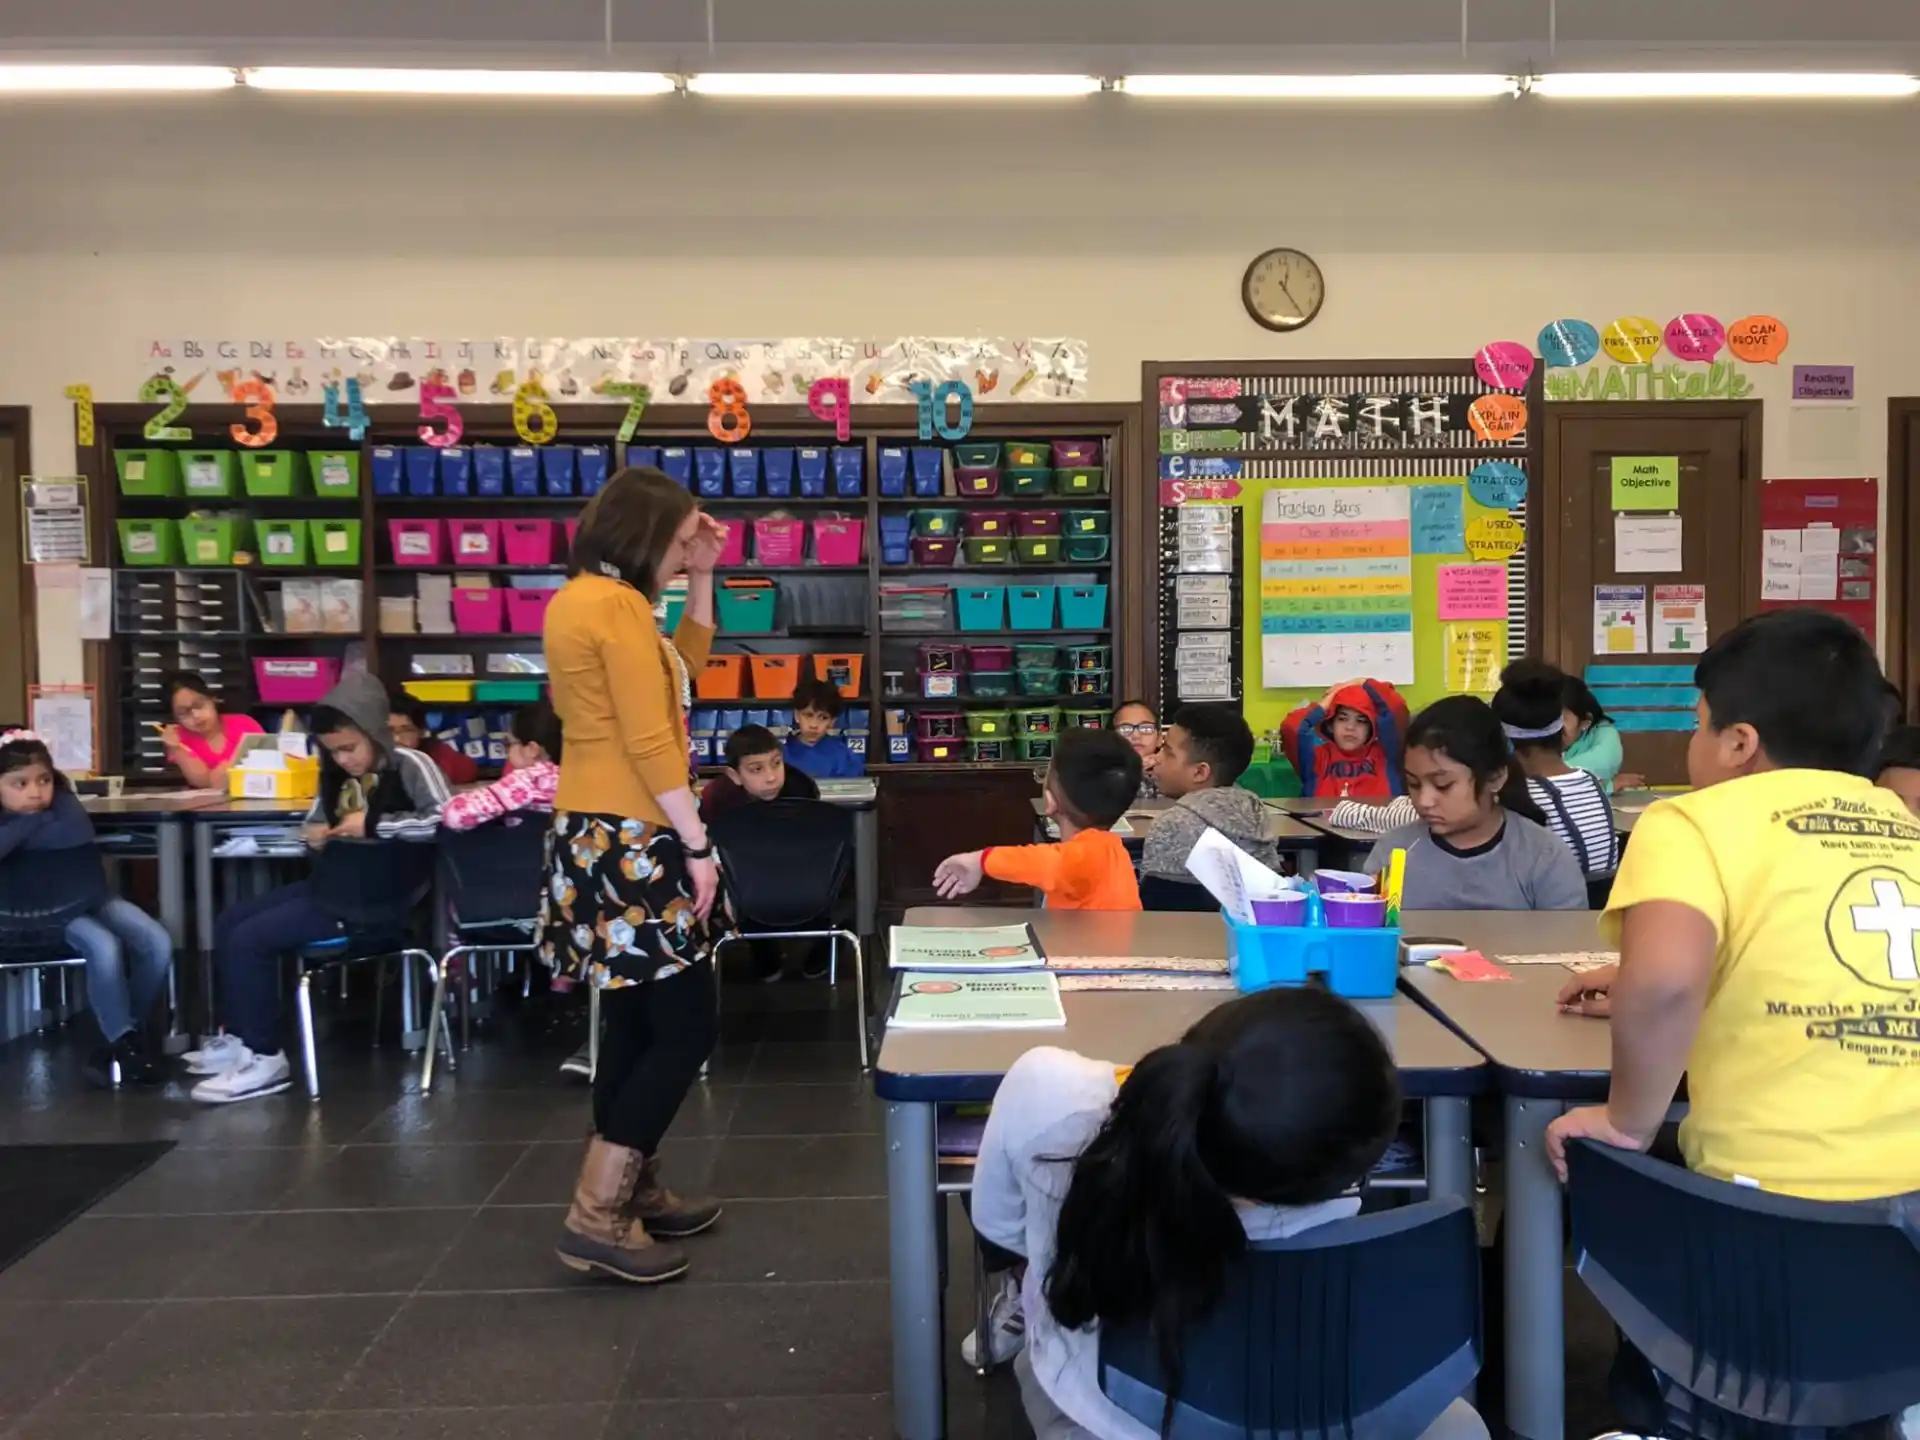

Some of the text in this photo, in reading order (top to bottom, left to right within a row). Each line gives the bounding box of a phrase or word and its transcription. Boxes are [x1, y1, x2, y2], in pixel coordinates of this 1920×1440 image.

[1749, 323, 1777, 335] CAN
[184, 340, 204, 358] Bb
[250, 341, 273, 359] Dd
[1634, 335, 1660, 346] STEP
[1478, 362, 1529, 374] SOUTION
[1804, 373, 1846, 385] Reading
[1798, 386, 1851, 398] Objective
[63, 383, 95, 446] 1
[139, 379, 192, 440] 2
[229, 376, 278, 448] 3
[323, 376, 370, 441] 4
[418, 376, 464, 448] 5
[512, 379, 558, 445] 6
[600, 379, 653, 443] 7
[707, 377, 751, 443] 8
[807, 377, 851, 442] 9
[908, 378, 973, 441] 10
[1262, 396, 1443, 439] MATH
[1632, 465, 1659, 475] Math
[1470, 475, 1526, 487] STRATEGY
[1620, 477, 1672, 489] Objective
[1277, 494, 1363, 518] Fraction Bars
[1486, 520, 1514, 530] USED
[1469, 540, 1521, 551] STRATEGY
[1456, 630, 1493, 641] WANING
[850, 739, 863, 751] 22
[892, 739, 907, 751] 23
[1833, 818, 1859, 832] for
[1860, 819, 1889, 837] My
[1765, 1000, 1855, 1017] Marcha
[1903, 997, 1920, 1013] J
[1885, 1019, 1919, 1038] Mi
[1839, 1038, 1888, 1056] Tengan
[1892, 1043, 1907, 1056] Fe
